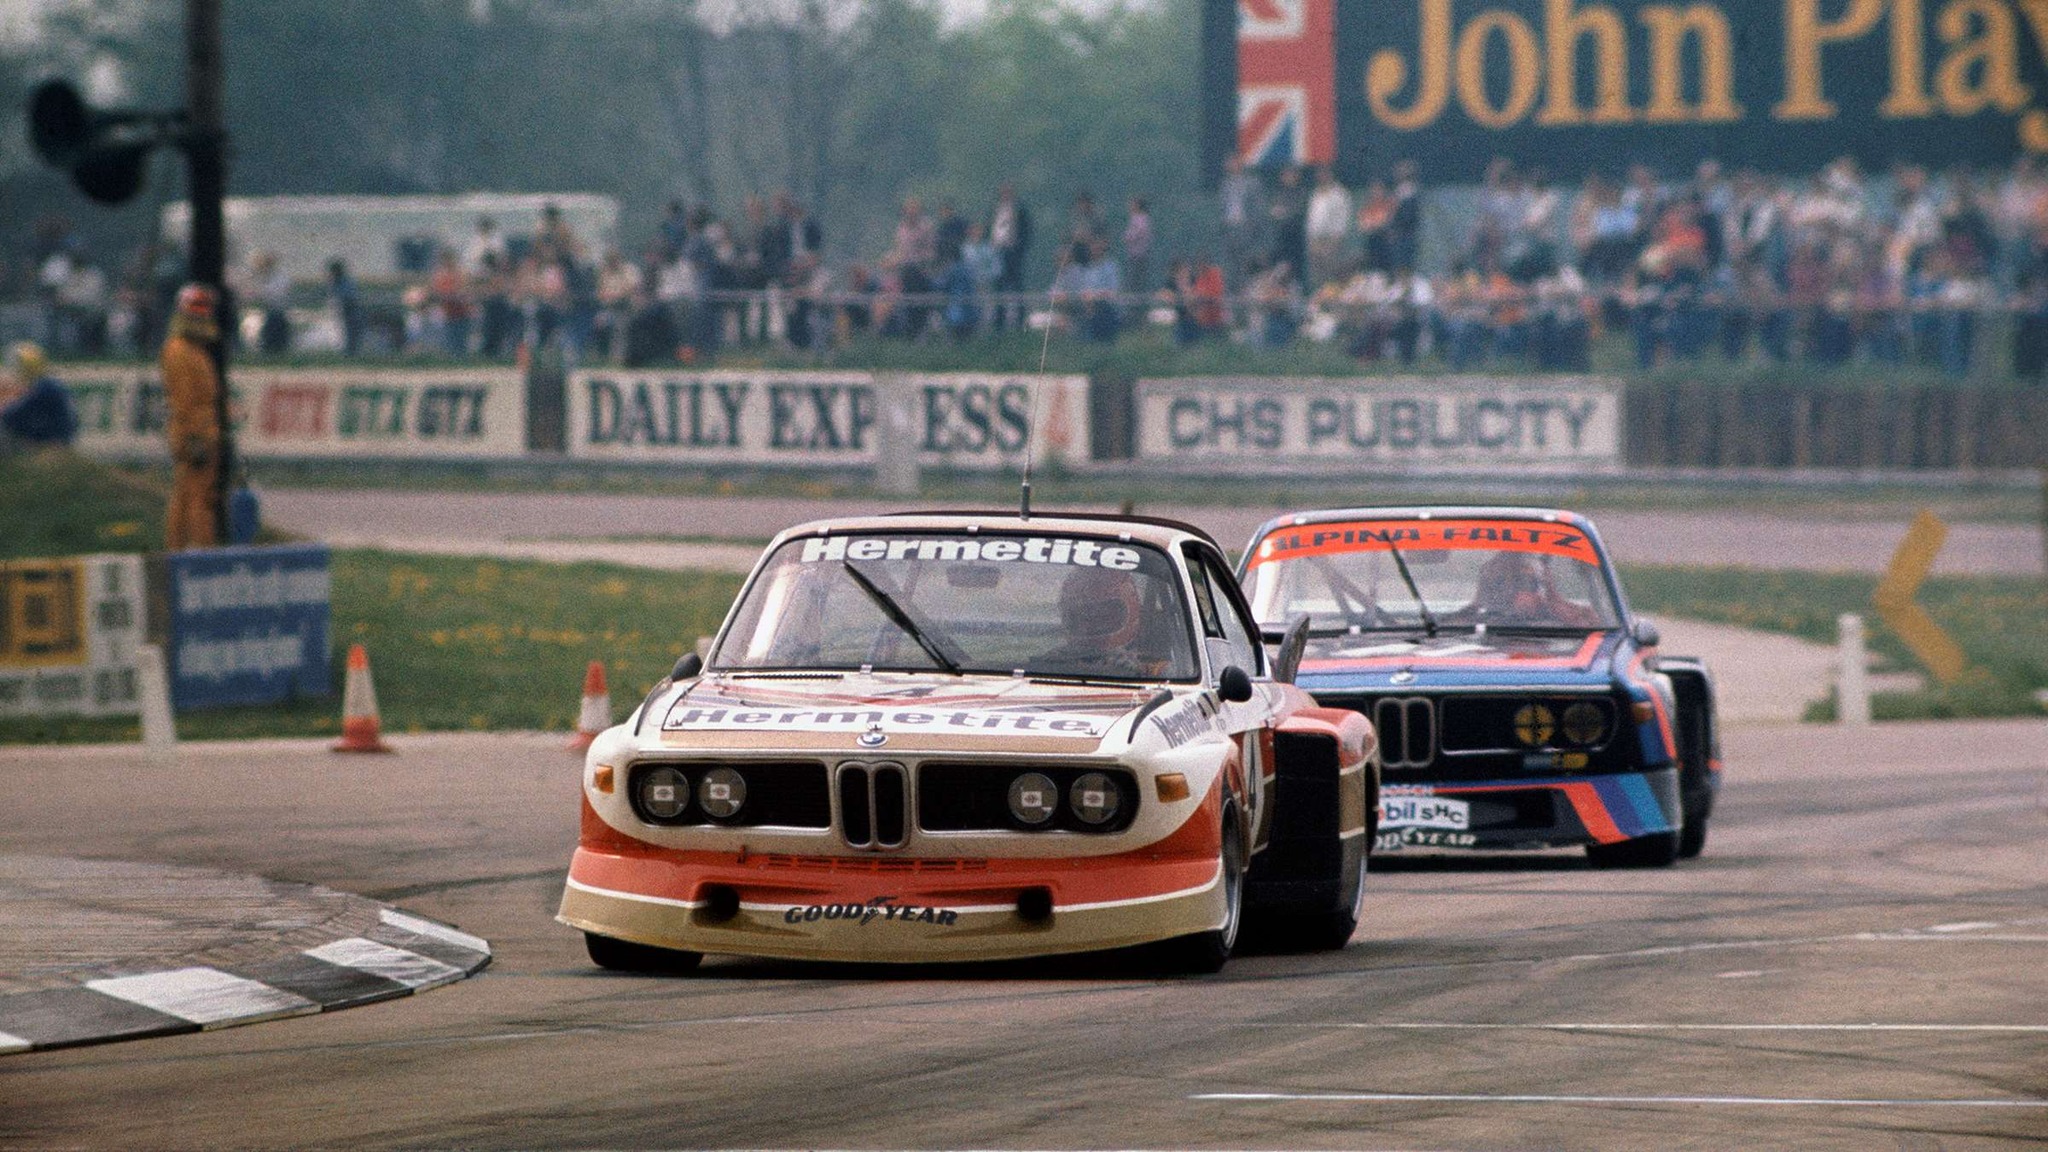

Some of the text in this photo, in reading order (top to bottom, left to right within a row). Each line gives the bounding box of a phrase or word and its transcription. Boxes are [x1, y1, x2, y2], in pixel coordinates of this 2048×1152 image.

[1365, 0, 1743, 129] John
[339, 383, 410, 438] GTX
[417, 382, 488, 438] GTX
[585, 379, 1031, 454] DAILY EXPESS
[1168, 398, 1600, 449] CHS PUBLICITY
[800, 535, 1141, 571] Hermetite
[681, 707, 1093, 733] Hermetite
